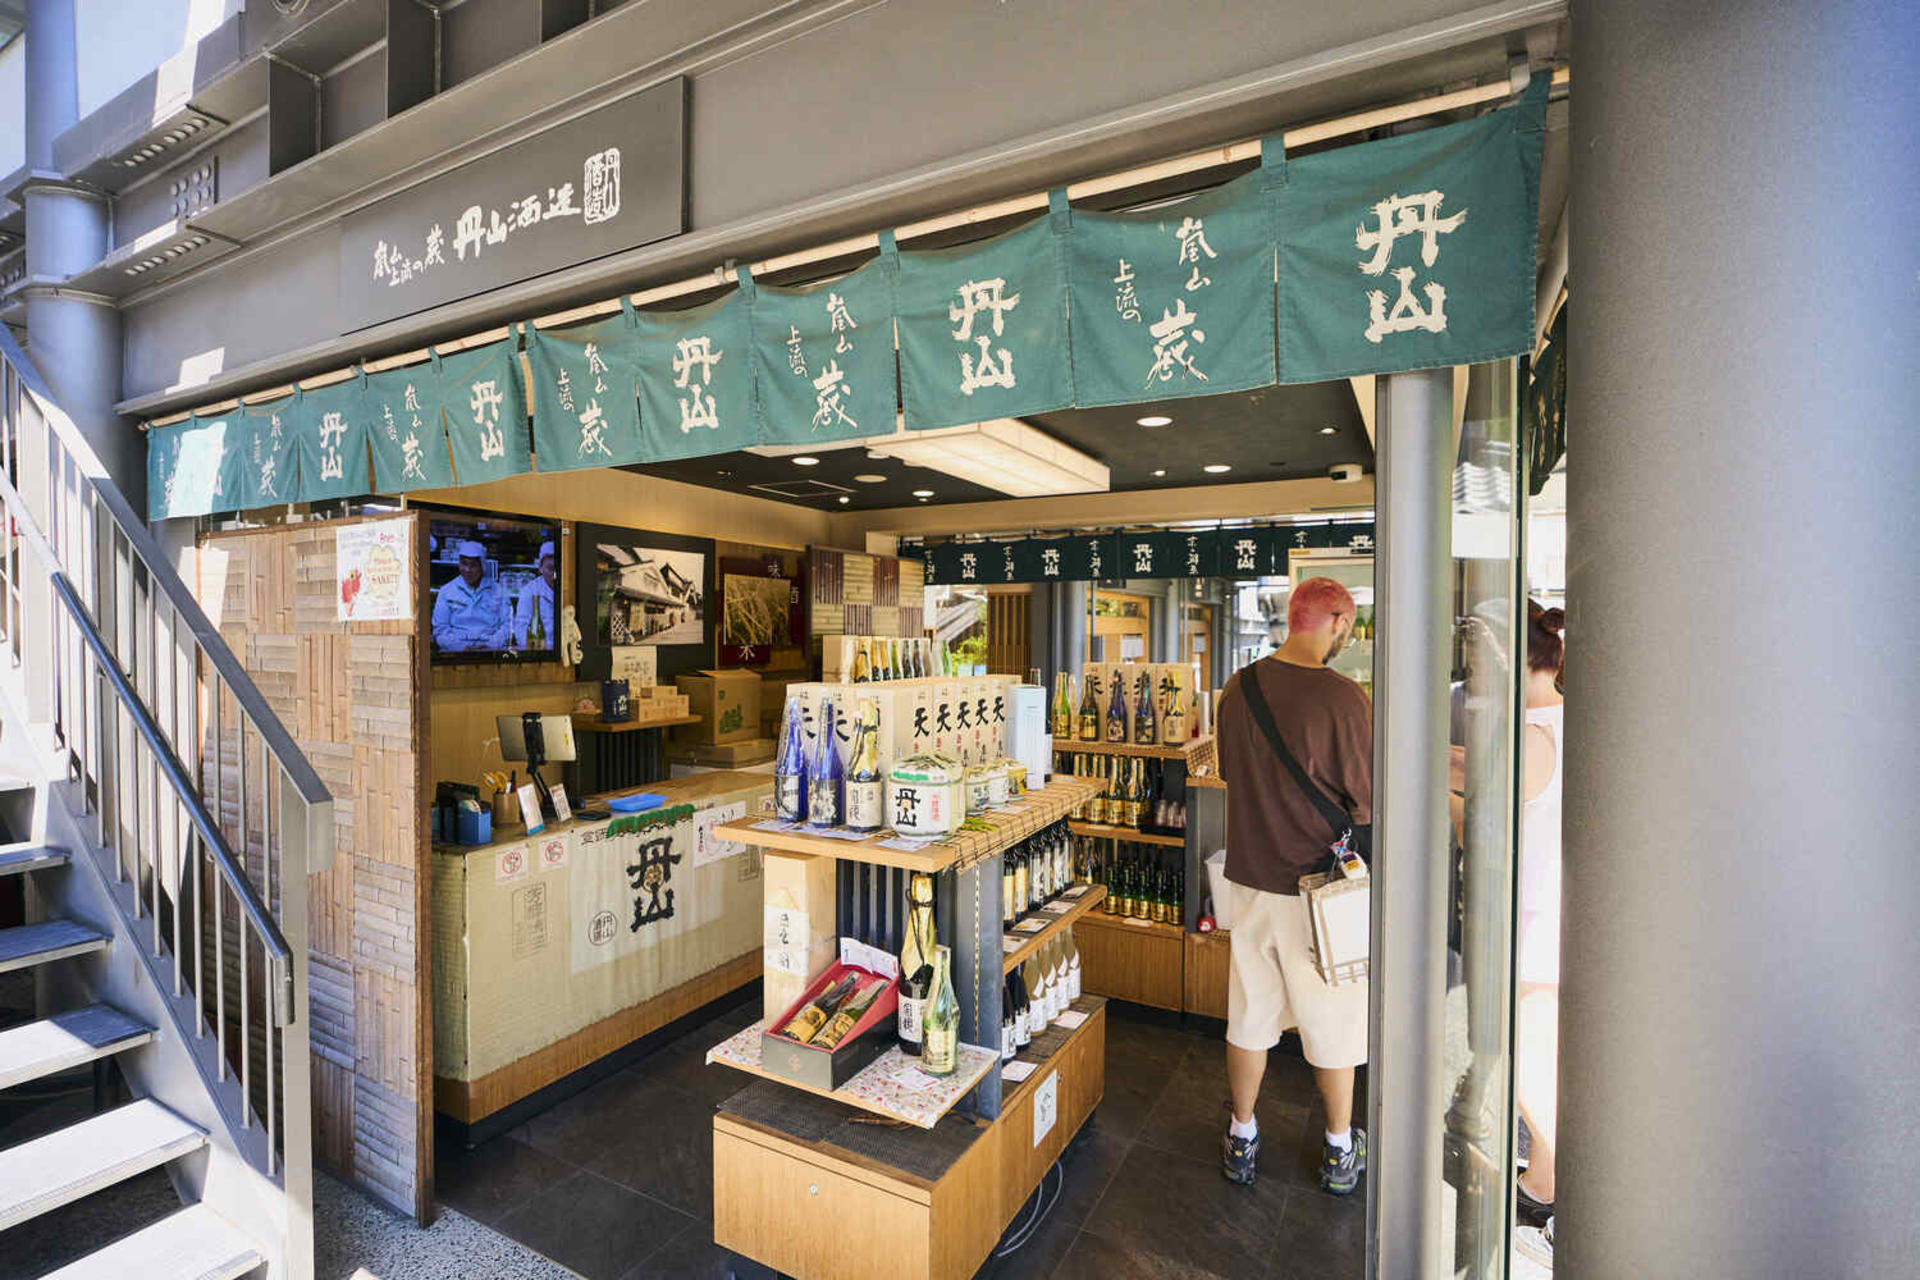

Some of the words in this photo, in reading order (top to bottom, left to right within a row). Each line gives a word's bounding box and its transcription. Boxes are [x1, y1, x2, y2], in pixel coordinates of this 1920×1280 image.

[1113, 257, 1142, 323] 上流の
[1355, 190, 1468, 343] 丹山
[786, 325, 808, 378] 上流の
[949, 277, 1022, 396] 丹山
[470, 379, 504, 462] 丹山
[557, 368, 575, 413] 上流の
[672, 335, 724, 434] 丹山
[319, 411, 348, 482] 丹山
[895, 788, 921, 827] 丹山
[626, 835, 682, 933] 丹山
